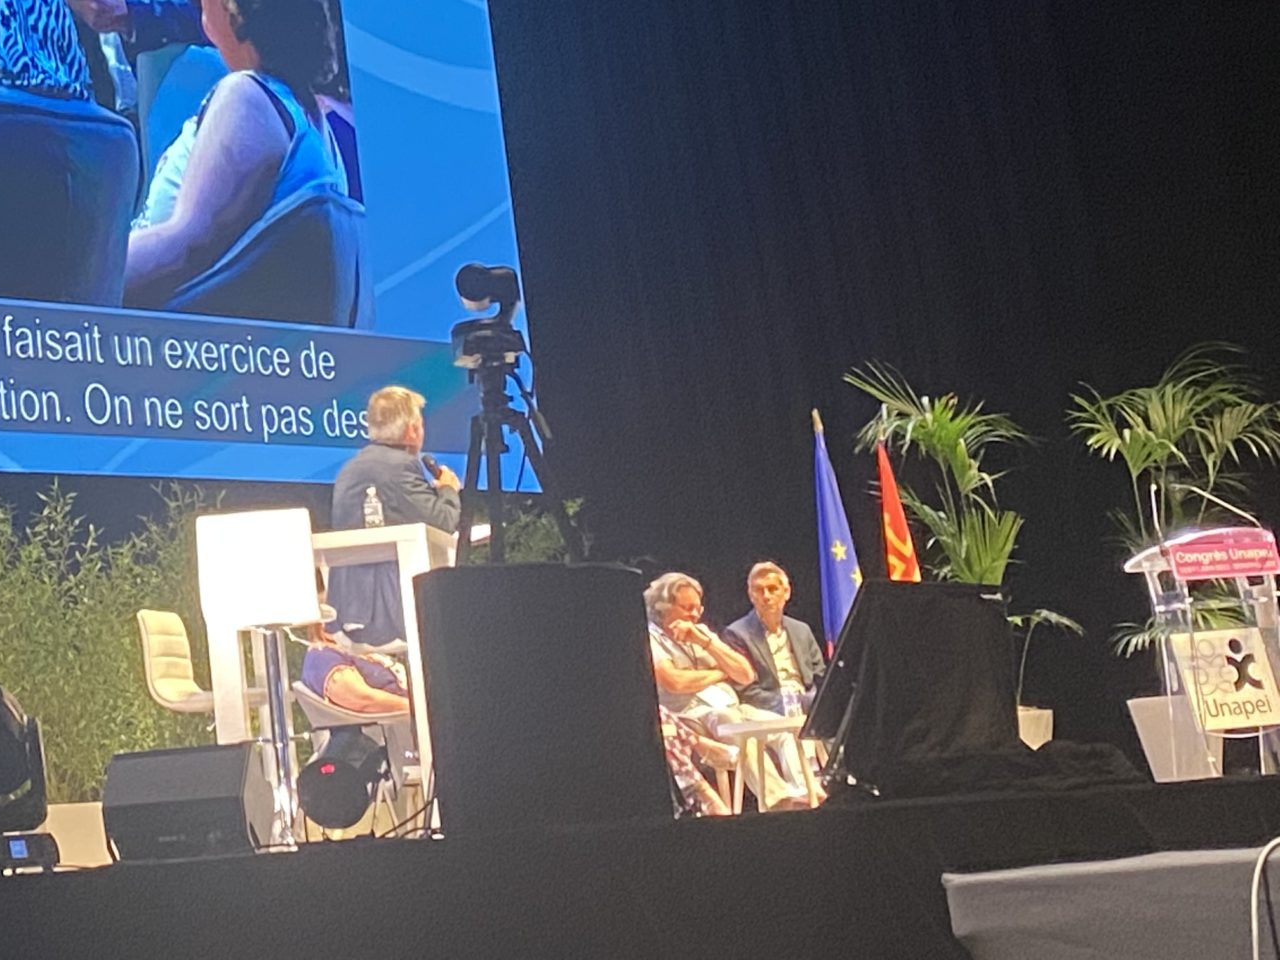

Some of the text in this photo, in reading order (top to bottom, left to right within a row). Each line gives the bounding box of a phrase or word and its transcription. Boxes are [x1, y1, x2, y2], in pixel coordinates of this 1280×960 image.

[3, 316, 104, 363] faisait
[114, 336, 152, 366] un
[164, 335, 290, 376] exercice
[300, 340, 336, 379] de
[85, 383, 132, 425] On
[145, 398, 183, 428] ne
[195, 396, 252, 432] sort
[261, 405, 313, 442] pas
[1205, 694, 1272, 719] Unapei
